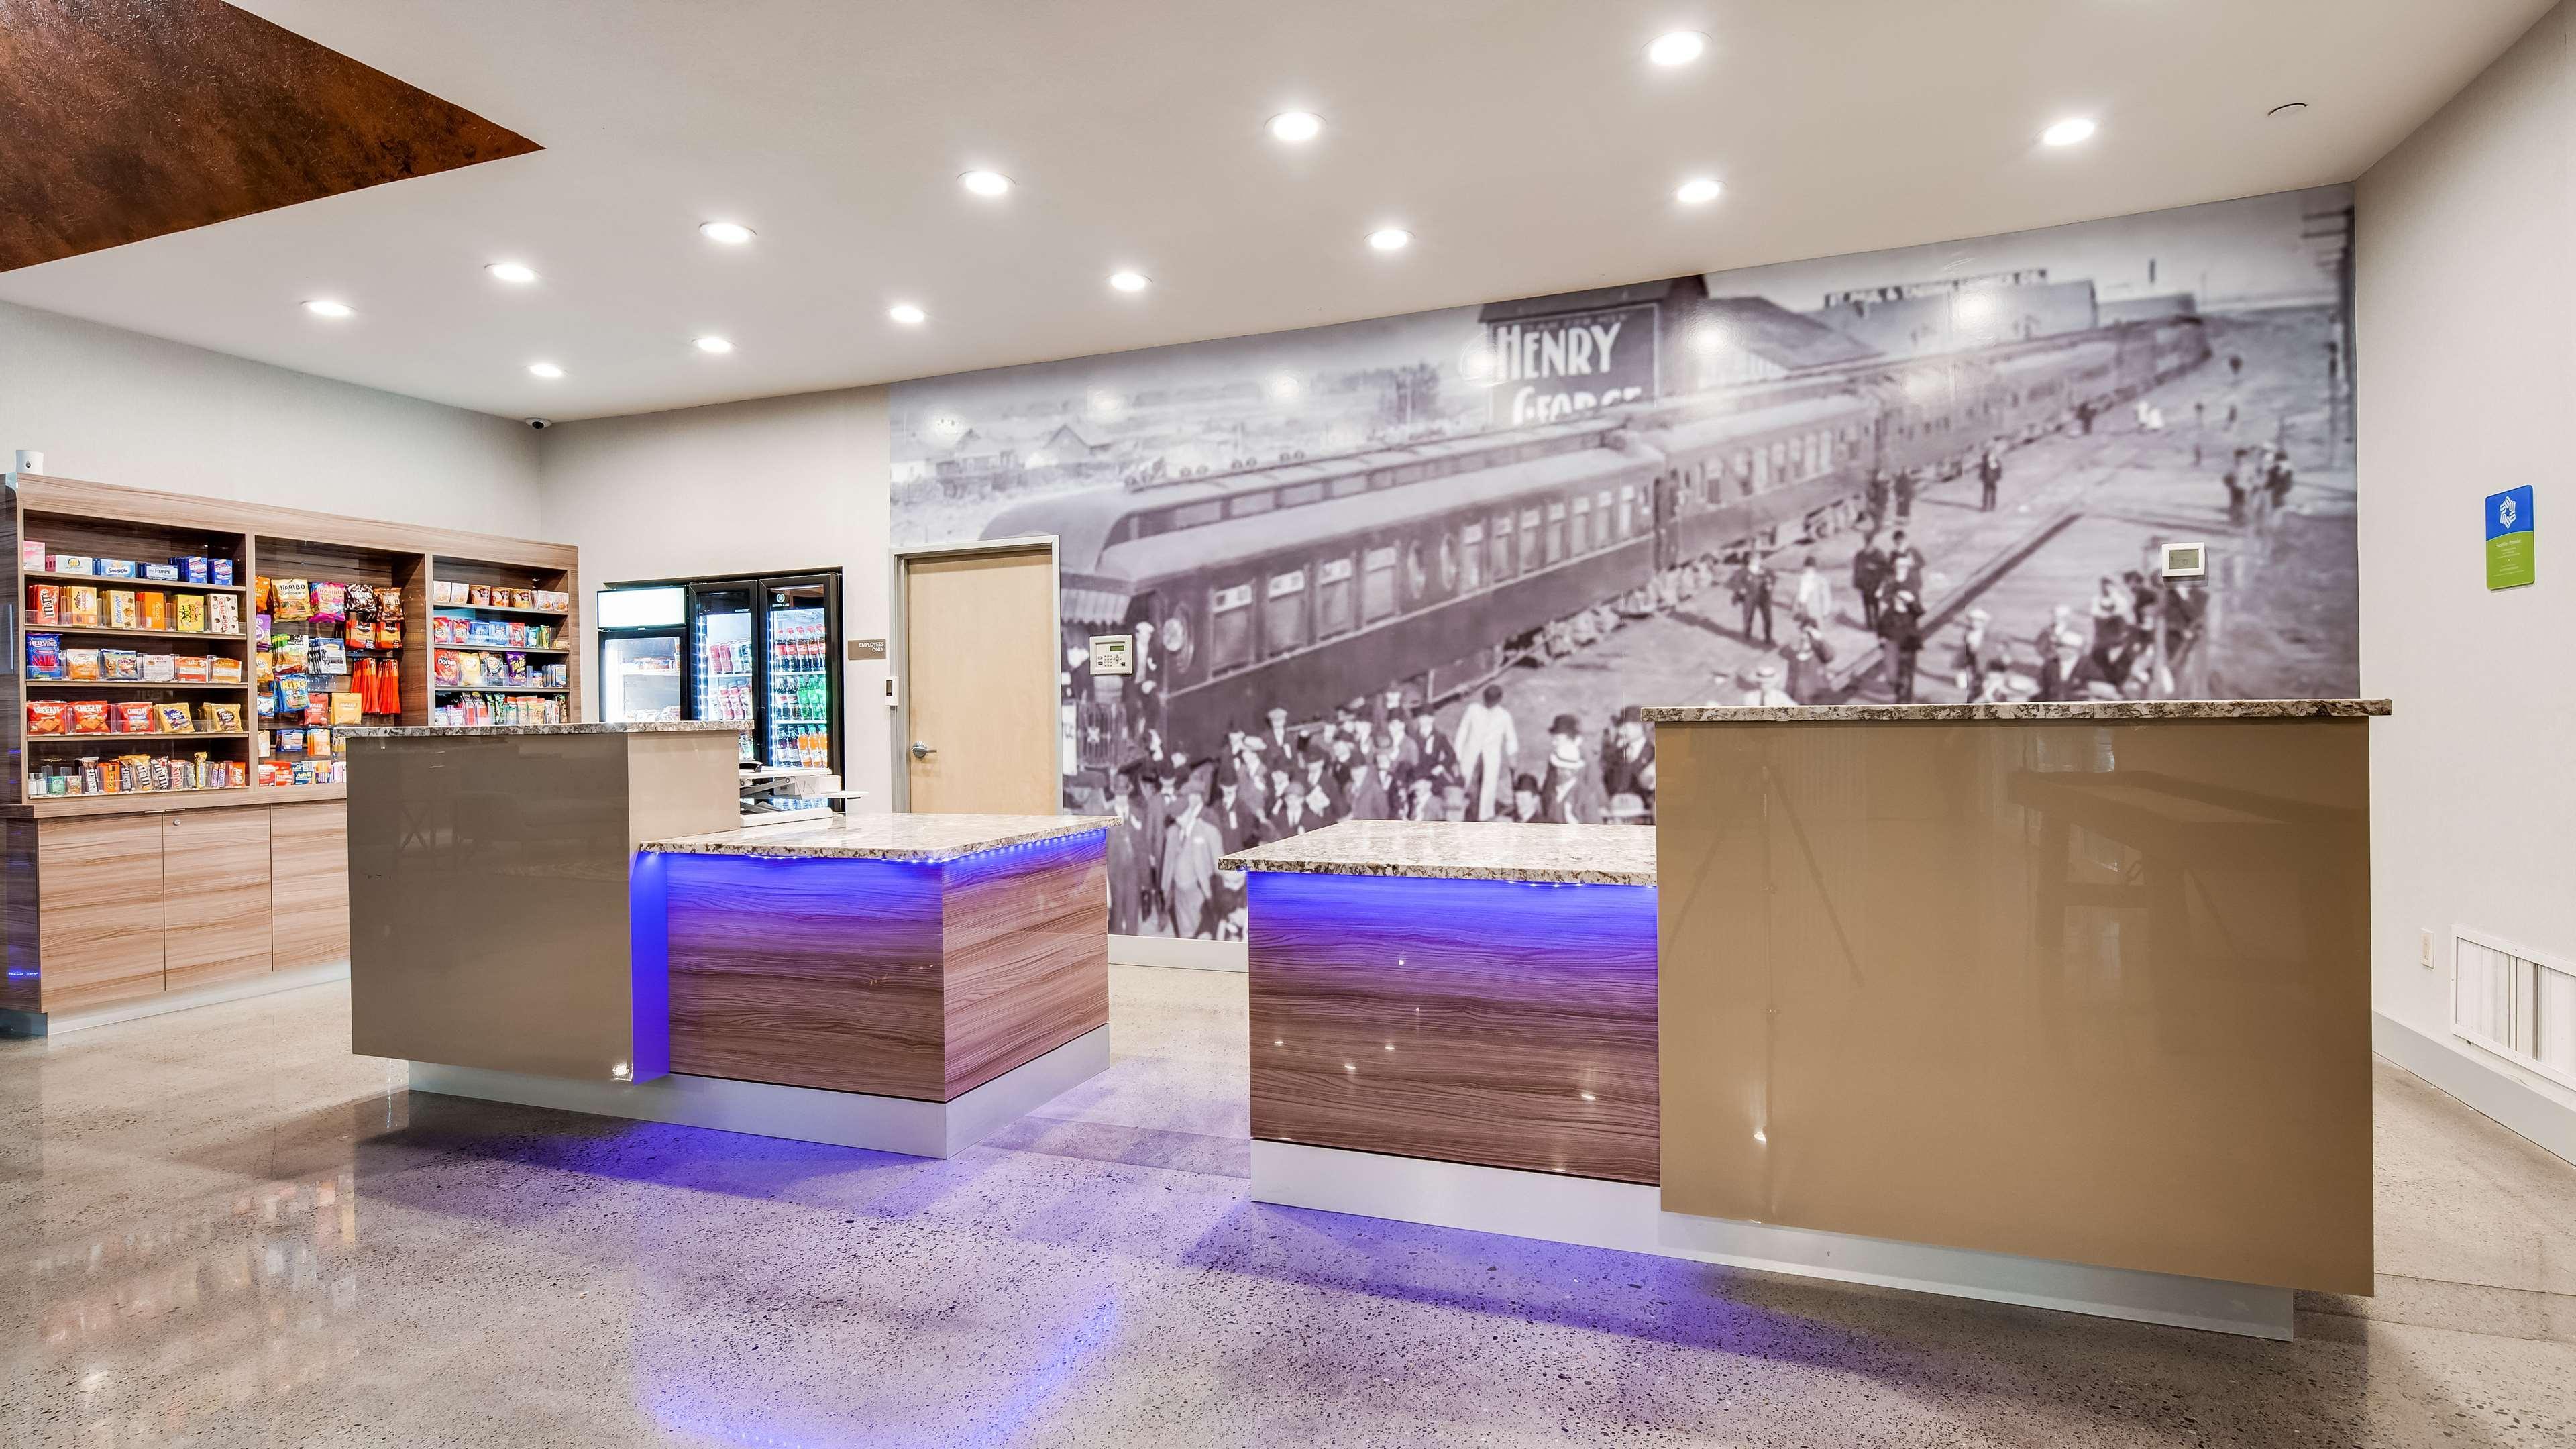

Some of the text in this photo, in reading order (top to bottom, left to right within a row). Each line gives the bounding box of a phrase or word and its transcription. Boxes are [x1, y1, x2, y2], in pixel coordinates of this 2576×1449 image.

[1497, 322, 1621, 381] HENRY
[154, 567, 171, 575] Purex
[218, 596, 229, 630] WHOPPERS
